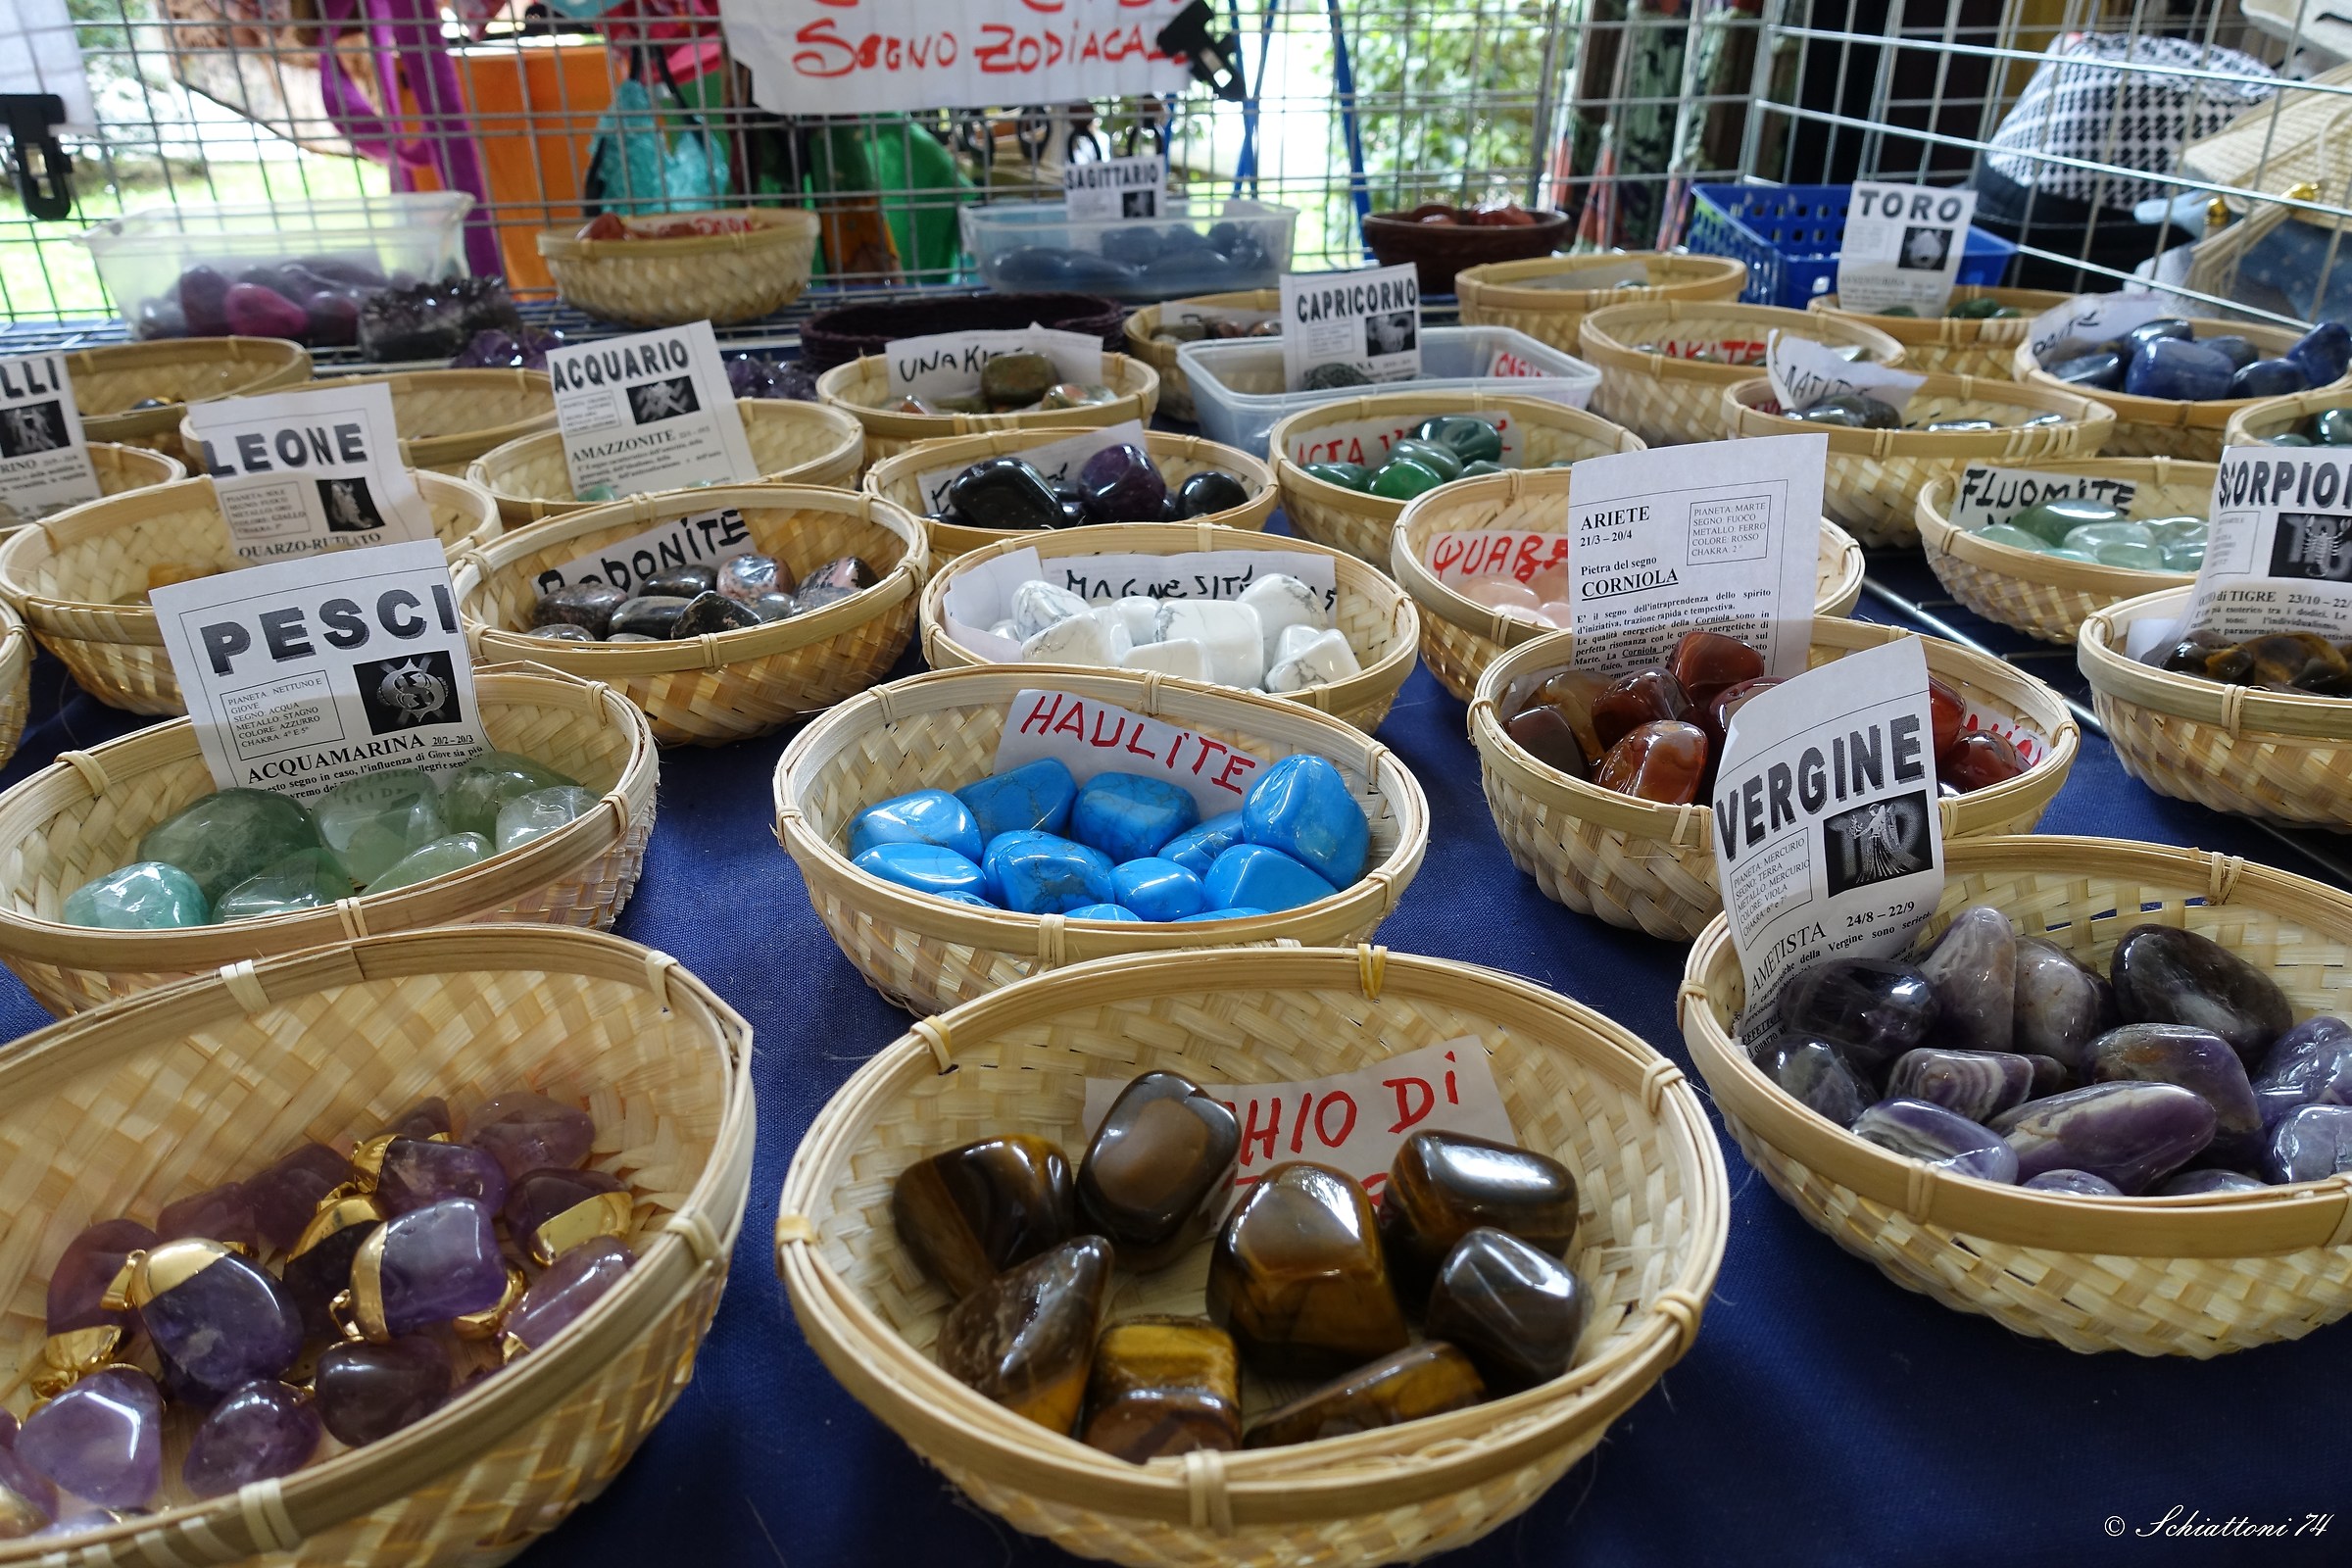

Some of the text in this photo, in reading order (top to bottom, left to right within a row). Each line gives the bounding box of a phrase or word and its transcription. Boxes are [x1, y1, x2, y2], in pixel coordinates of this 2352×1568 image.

[1067, 164, 1158, 189] SAGITTARIO
[1859, 190, 1963, 222] TORO
[1297, 278, 1417, 322] CAPRICORNO
[553, 339, 689, 394] ACQUARIO
[201, 423, 368, 478] LEONE
[571, 429, 675, 463] AMAZZONITE
[1581, 506, 1650, 530] ARIETE
[1727, 514, 1756, 523] FUOCO
[1735, 502, 1766, 513] MARTE
[1580, 534, 1600, 547] 21/3
[1611, 529, 1633, 542] 20/4
[1731, 533, 1759, 543] ROSSO
[1739, 521, 1766, 532] FERRO
[1581, 557, 1657, 576] Pietra del segno
[1581, 567, 1679, 598] CORNIOLA
[1634, 596, 1709, 613] dell'intraprendenza
[1716, 591, 1737, 601] dello
[1743, 588, 1772, 600] spirito
[2217, 591, 2227, 601] di
[2230, 591, 2277, 602] TIGRE
[2288, 594, 2321, 605] 23/10
[200, 584, 460, 677] PESCI
[1577, 620, 1622, 635] d'iniziativa,
[1624, 614, 1656, 625] trazione
[1657, 610, 1682, 620] rapida
[1690, 603, 1736, 615] tempestiva.
[1592, 631, 1618, 643] qualità
[1622, 623, 1666, 636] energetiche
[1671, 619, 1690, 628] della
[1693, 614, 1731, 626] Corniola
[1575, 646, 1606, 658] perfetta
[1609, 638, 1646, 650] risonanza
[1708, 622, 1756, 633] energetiche
[1760, 620, 1769, 629] di
[1574, 657, 1600, 666] Marte.
[1622, 646, 1657, 660] Corniola
[1600, 657, 1660, 671] fisico, mentale
[272, 679, 315, 694] NETTUNO
[230, 702, 260, 714] GIOVE
[269, 702, 300, 714] ACQUA
[283, 706, 318, 720] STAGNO
[279, 714, 320, 730] AZZURRO
[249, 733, 425, 784] ACQUAMARINA
[432, 736, 449, 745] 20/2
[456, 734, 474, 743] 20/3
[289, 777, 318, 788] segno
[333, 767, 359, 779] caso,
[361, 758, 413, 774] l'influenza
[416, 752, 425, 761] di
[427, 750, 452, 760] Giove
[467, 746, 483, 757] più
[1716, 713, 1926, 863] VERGINE
[1763, 837, 1805, 866] MERCURIO
[1758, 861, 1784, 882] TERRA
[1769, 858, 1810, 888] MERCURIO
[1764, 883, 1788, 902] VIOLA
[1846, 910, 1874, 927] 24/8
[1888, 901, 1915, 917] 22/9
[1799, 950, 1821, 964] della
[1828, 933, 1864, 953] Vergine
[1871, 926, 1895, 939] sono
[1750, 921, 1827, 997] AMETISTA
